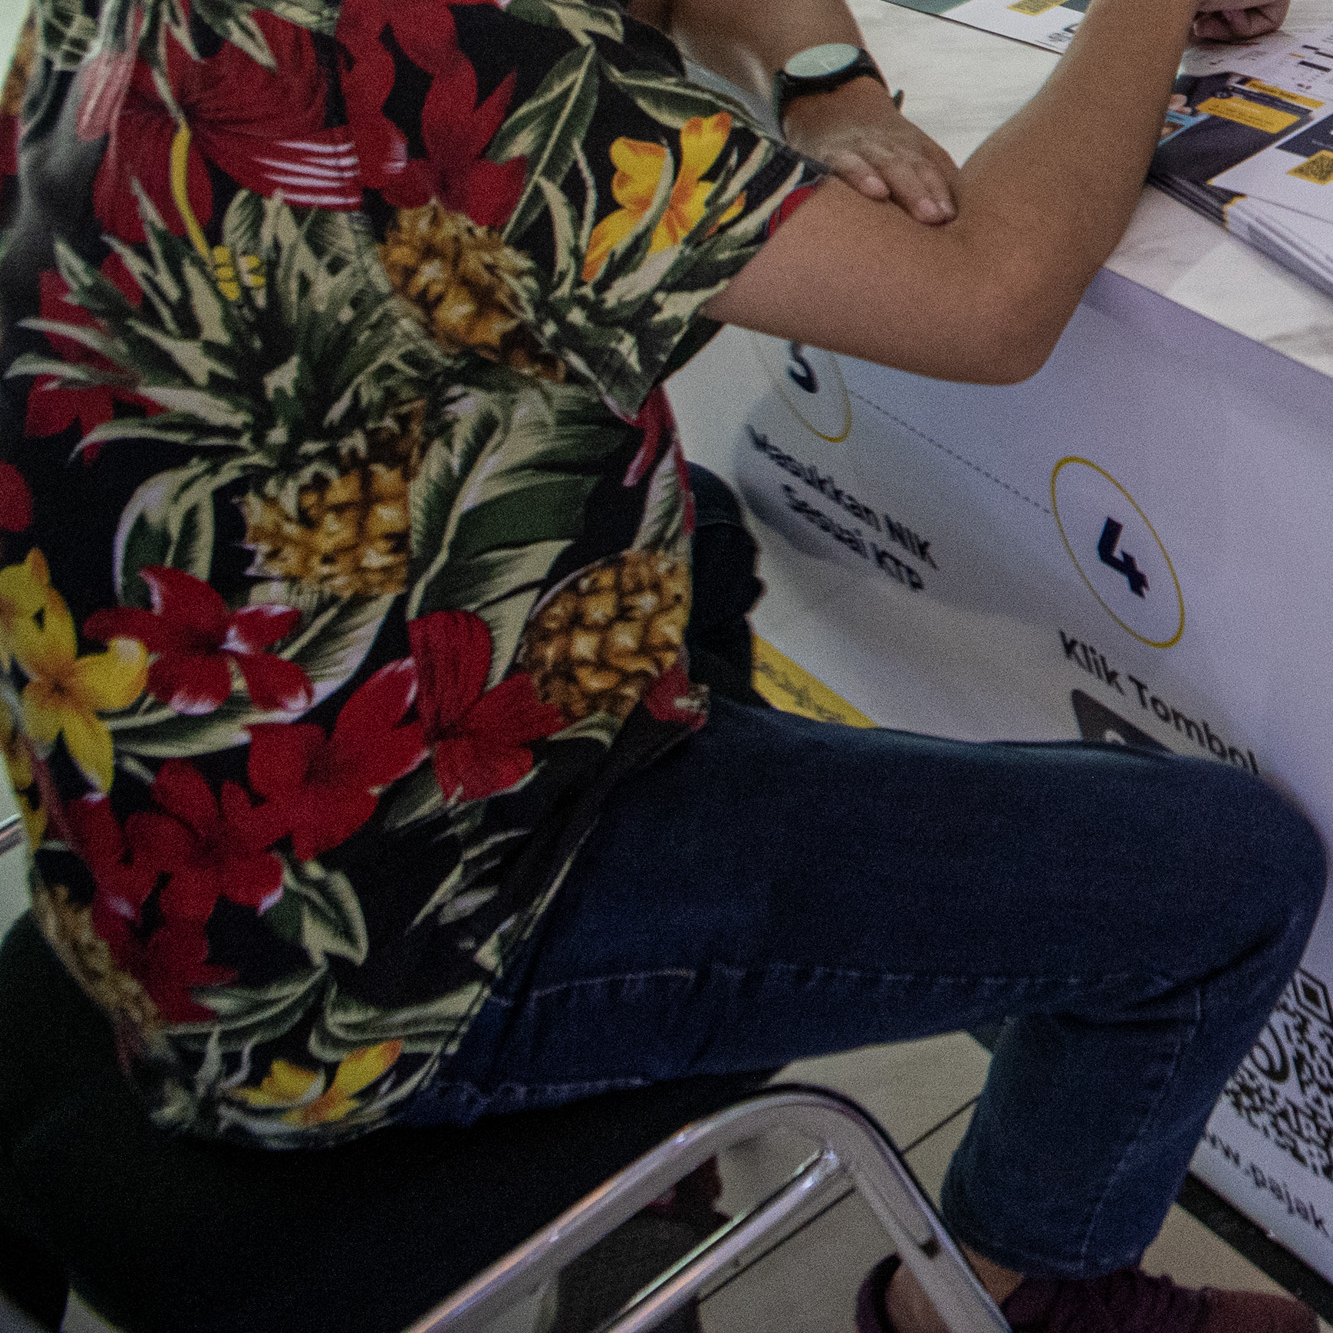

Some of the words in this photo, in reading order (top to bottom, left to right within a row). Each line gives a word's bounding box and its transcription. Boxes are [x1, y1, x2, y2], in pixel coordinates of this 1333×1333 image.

[870, 542, 925, 591] KTP
[885, 516, 940, 571] NIK
[1097, 517, 1151, 600] 4
[1059, 629, 1126, 697] Klik
[1128, 674, 1260, 776] Tombol
